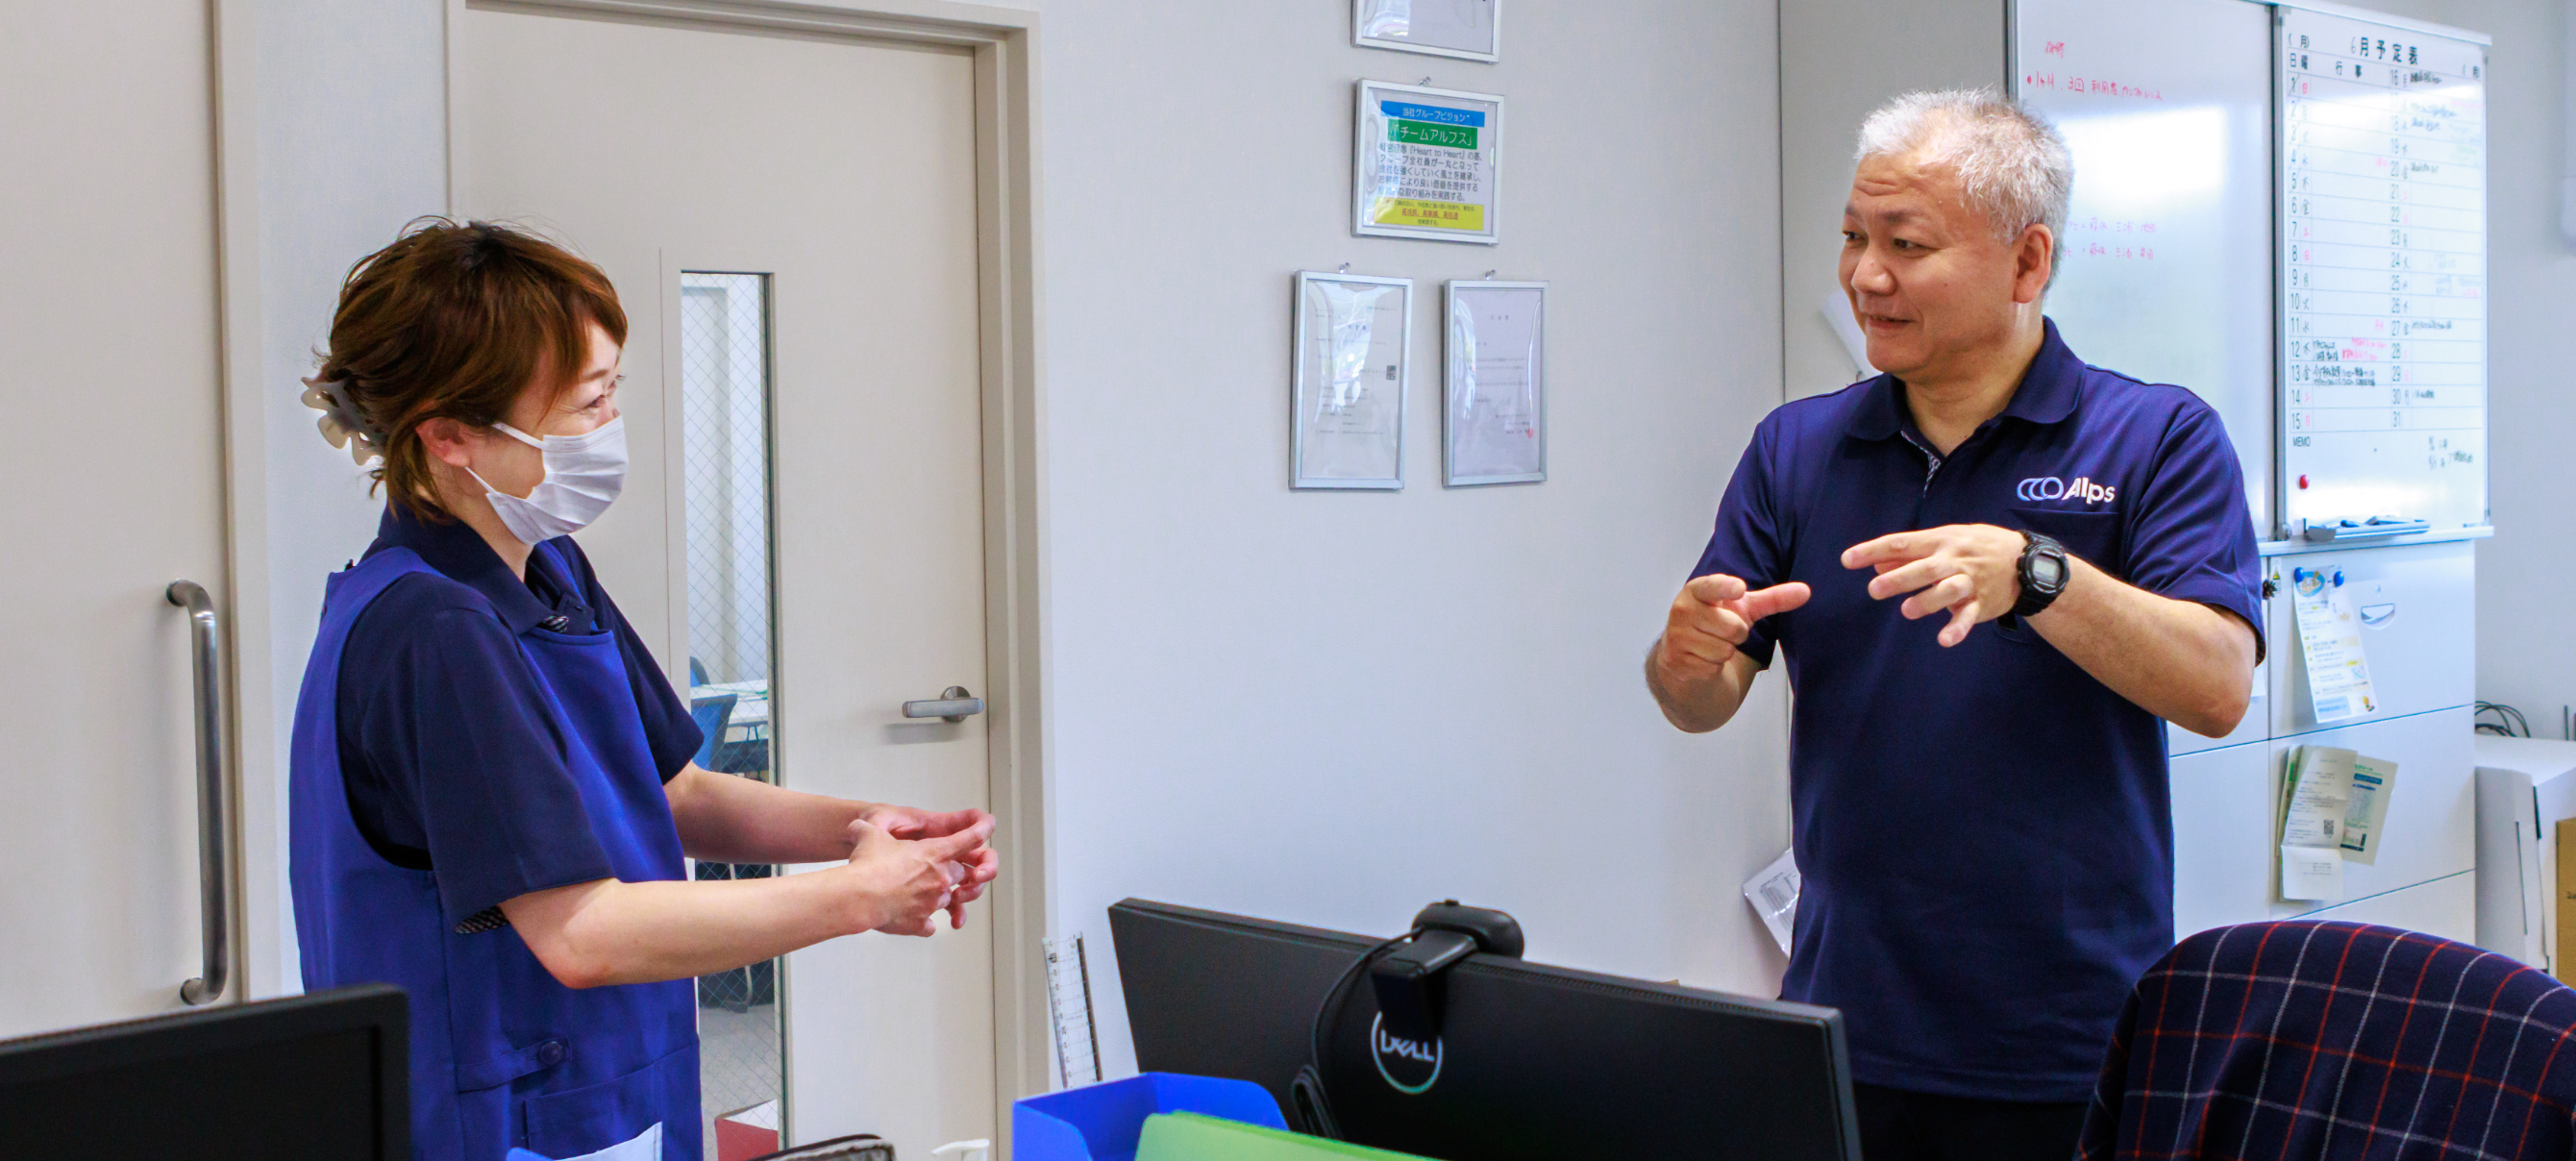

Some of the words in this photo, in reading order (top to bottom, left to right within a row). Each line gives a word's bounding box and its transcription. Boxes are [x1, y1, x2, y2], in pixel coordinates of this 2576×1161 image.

[2391, 69, 2398, 86] 16
[2391, 138, 2399, 154] 19
[2391, 184, 2399, 199] 21
[2291, 196, 2297, 213] 6
[2391, 207, 2400, 223] 22
[2292, 221, 2297, 237] 7
[2391, 229, 2400, 245] 23
[2291, 245, 2297, 261] 8
[2391, 252, 2400, 268] 24
[2292, 268, 2297, 285] 9
[2391, 275, 2400, 291] 25
[2291, 293, 2300, 310] 10
[2391, 297, 2400, 313] 26
[2291, 317, 2300, 333] 11
[2391, 320, 2400, 336] 27
[2291, 341, 2300, 358] 12
[2392, 343, 2400, 359] 28
[2291, 364, 2300, 383] 13
[2392, 365, 2400, 382] 29
[2291, 389, 2300, 405] 14
[2392, 388, 2401, 405] 30
[2291, 412, 2301, 430] 15
[2392, 411, 2400, 428] 31
[2292, 436, 2312, 448] MEMO
[2062, 477, 2116, 505] Alps
[1381, 1028, 1434, 1062] DELL
